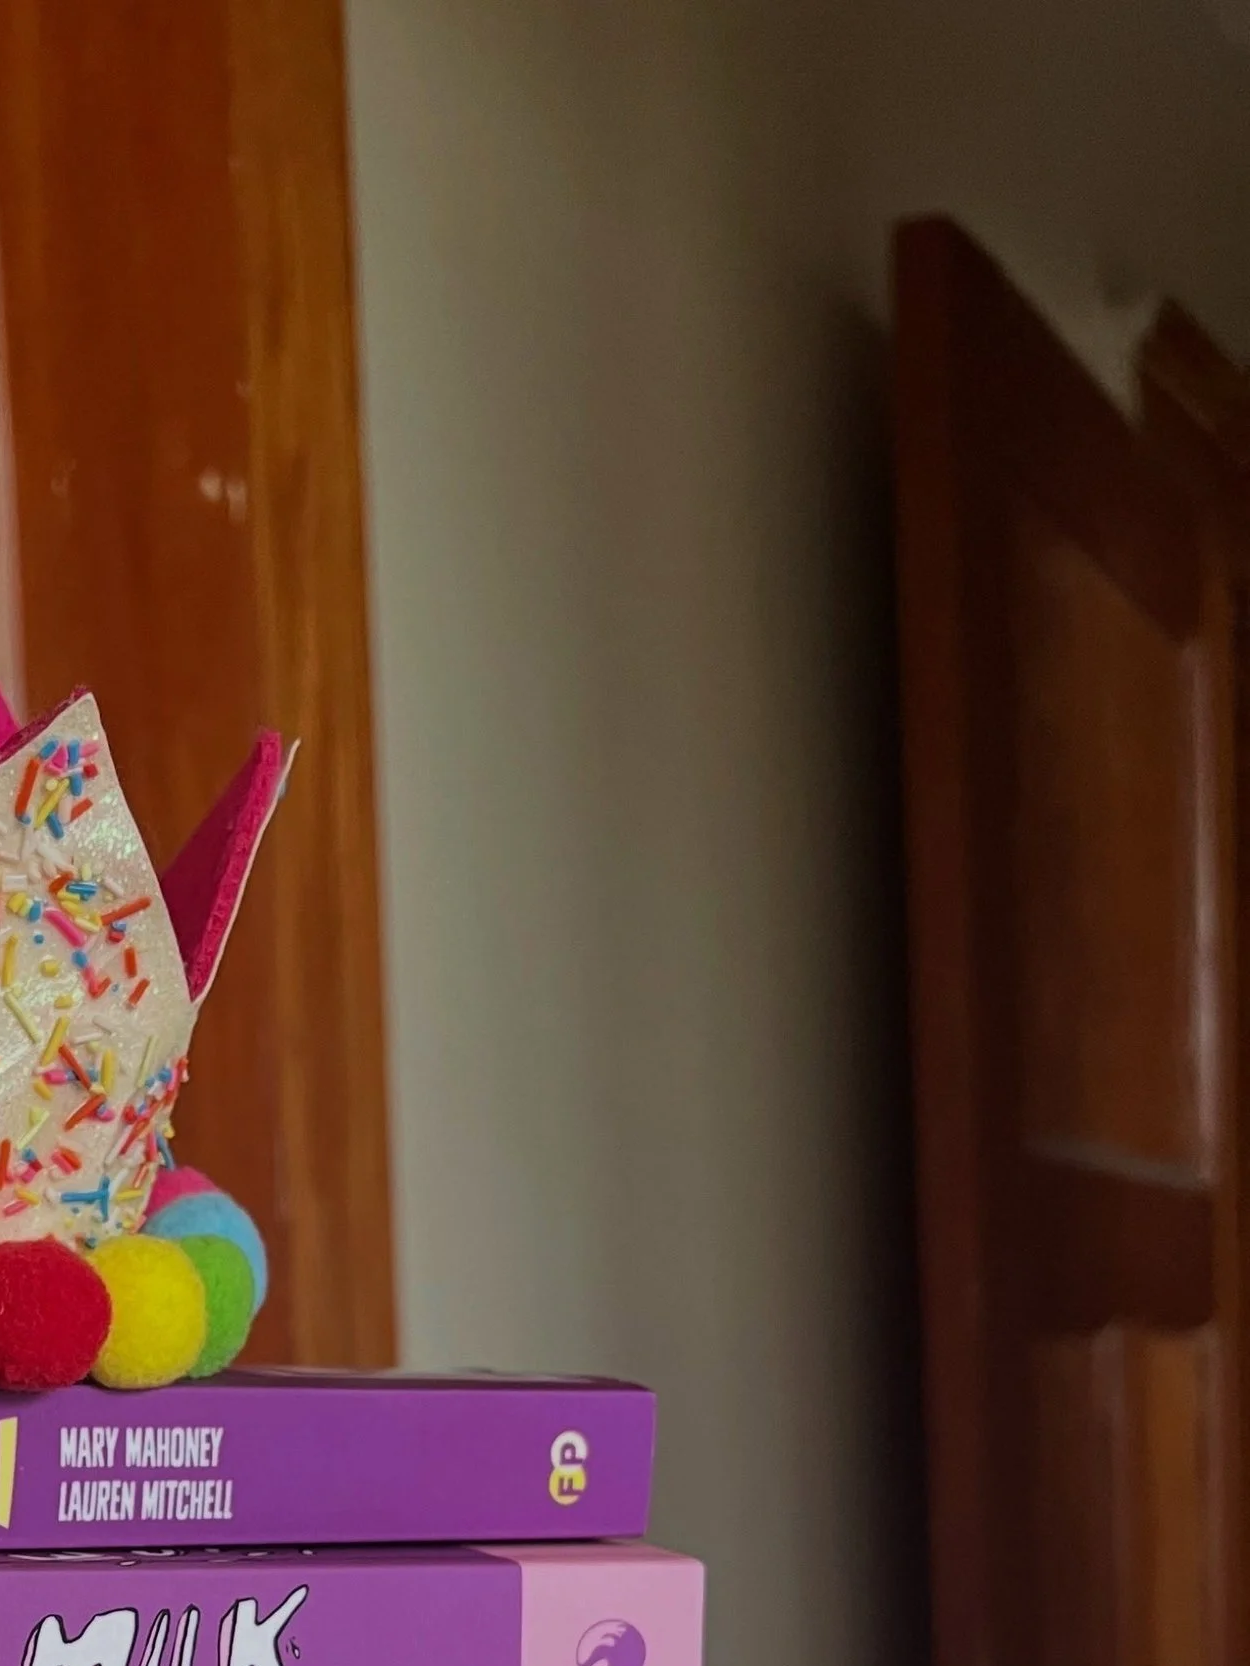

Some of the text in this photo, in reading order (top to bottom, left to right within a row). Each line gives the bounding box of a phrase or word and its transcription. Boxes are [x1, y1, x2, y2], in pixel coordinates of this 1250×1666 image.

[59, 1426, 224, 1468] MARY MAHONEY
[58, 1479, 233, 1522] LAUREN MITCHELL
